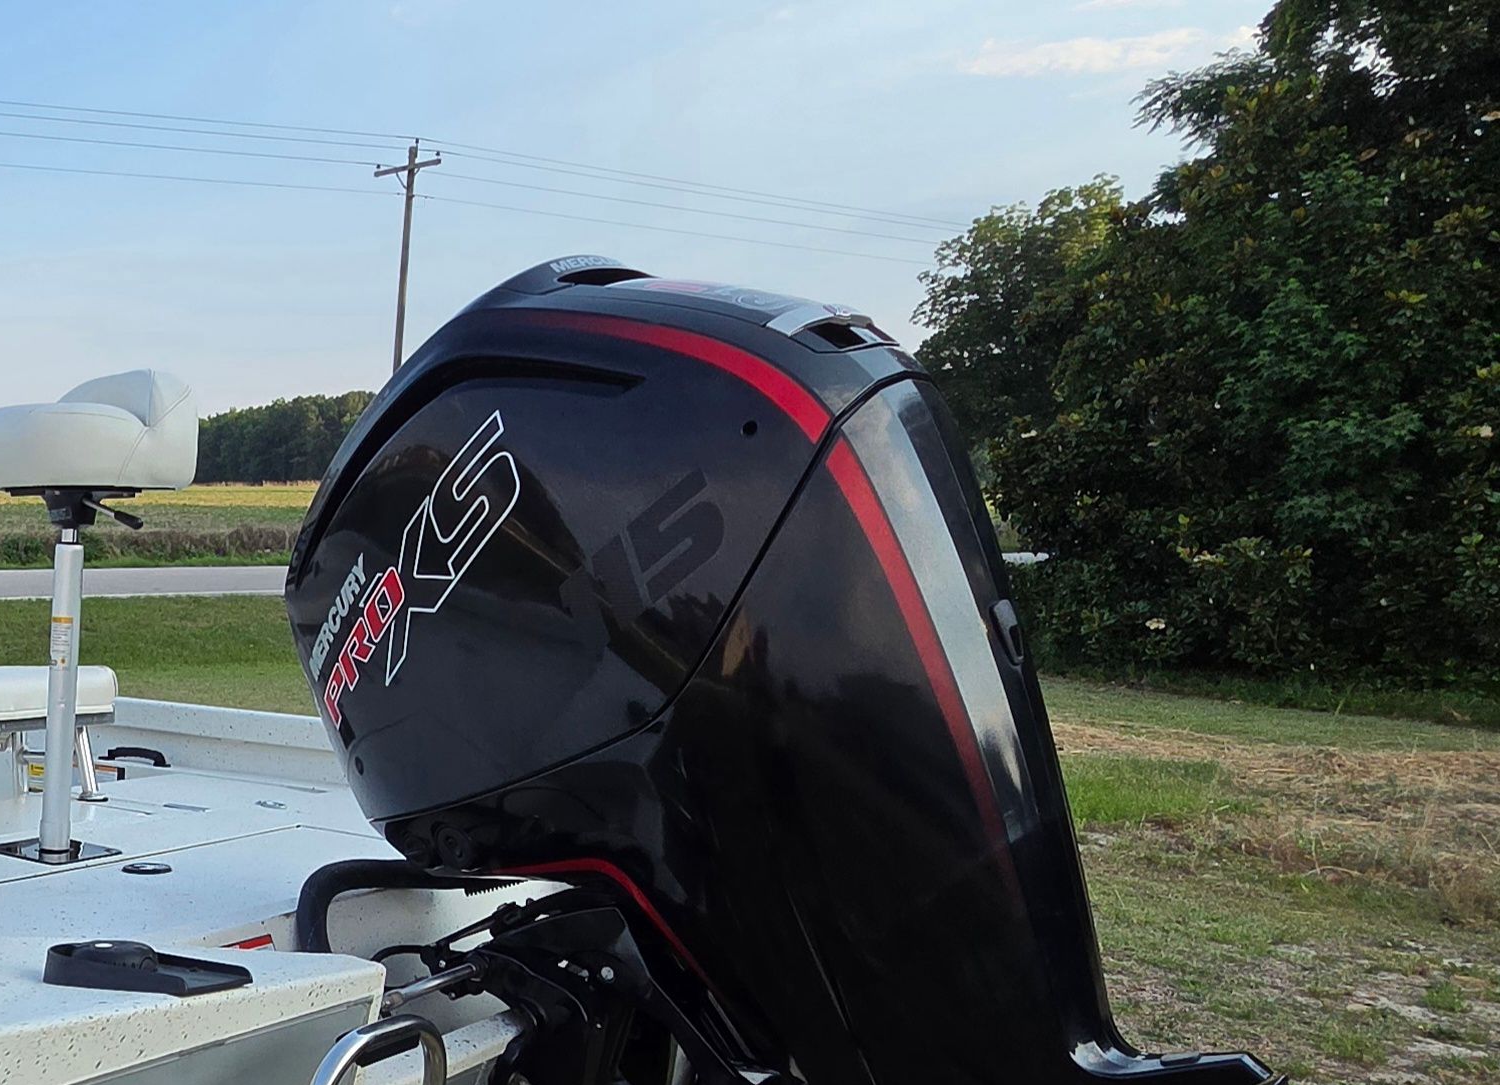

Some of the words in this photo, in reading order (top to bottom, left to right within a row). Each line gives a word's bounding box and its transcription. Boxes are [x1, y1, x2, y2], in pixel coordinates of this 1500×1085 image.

[549, 257, 621, 273] MERCU
[308, 552, 366, 682] MERCURY
[324, 566, 405, 730] PRO
